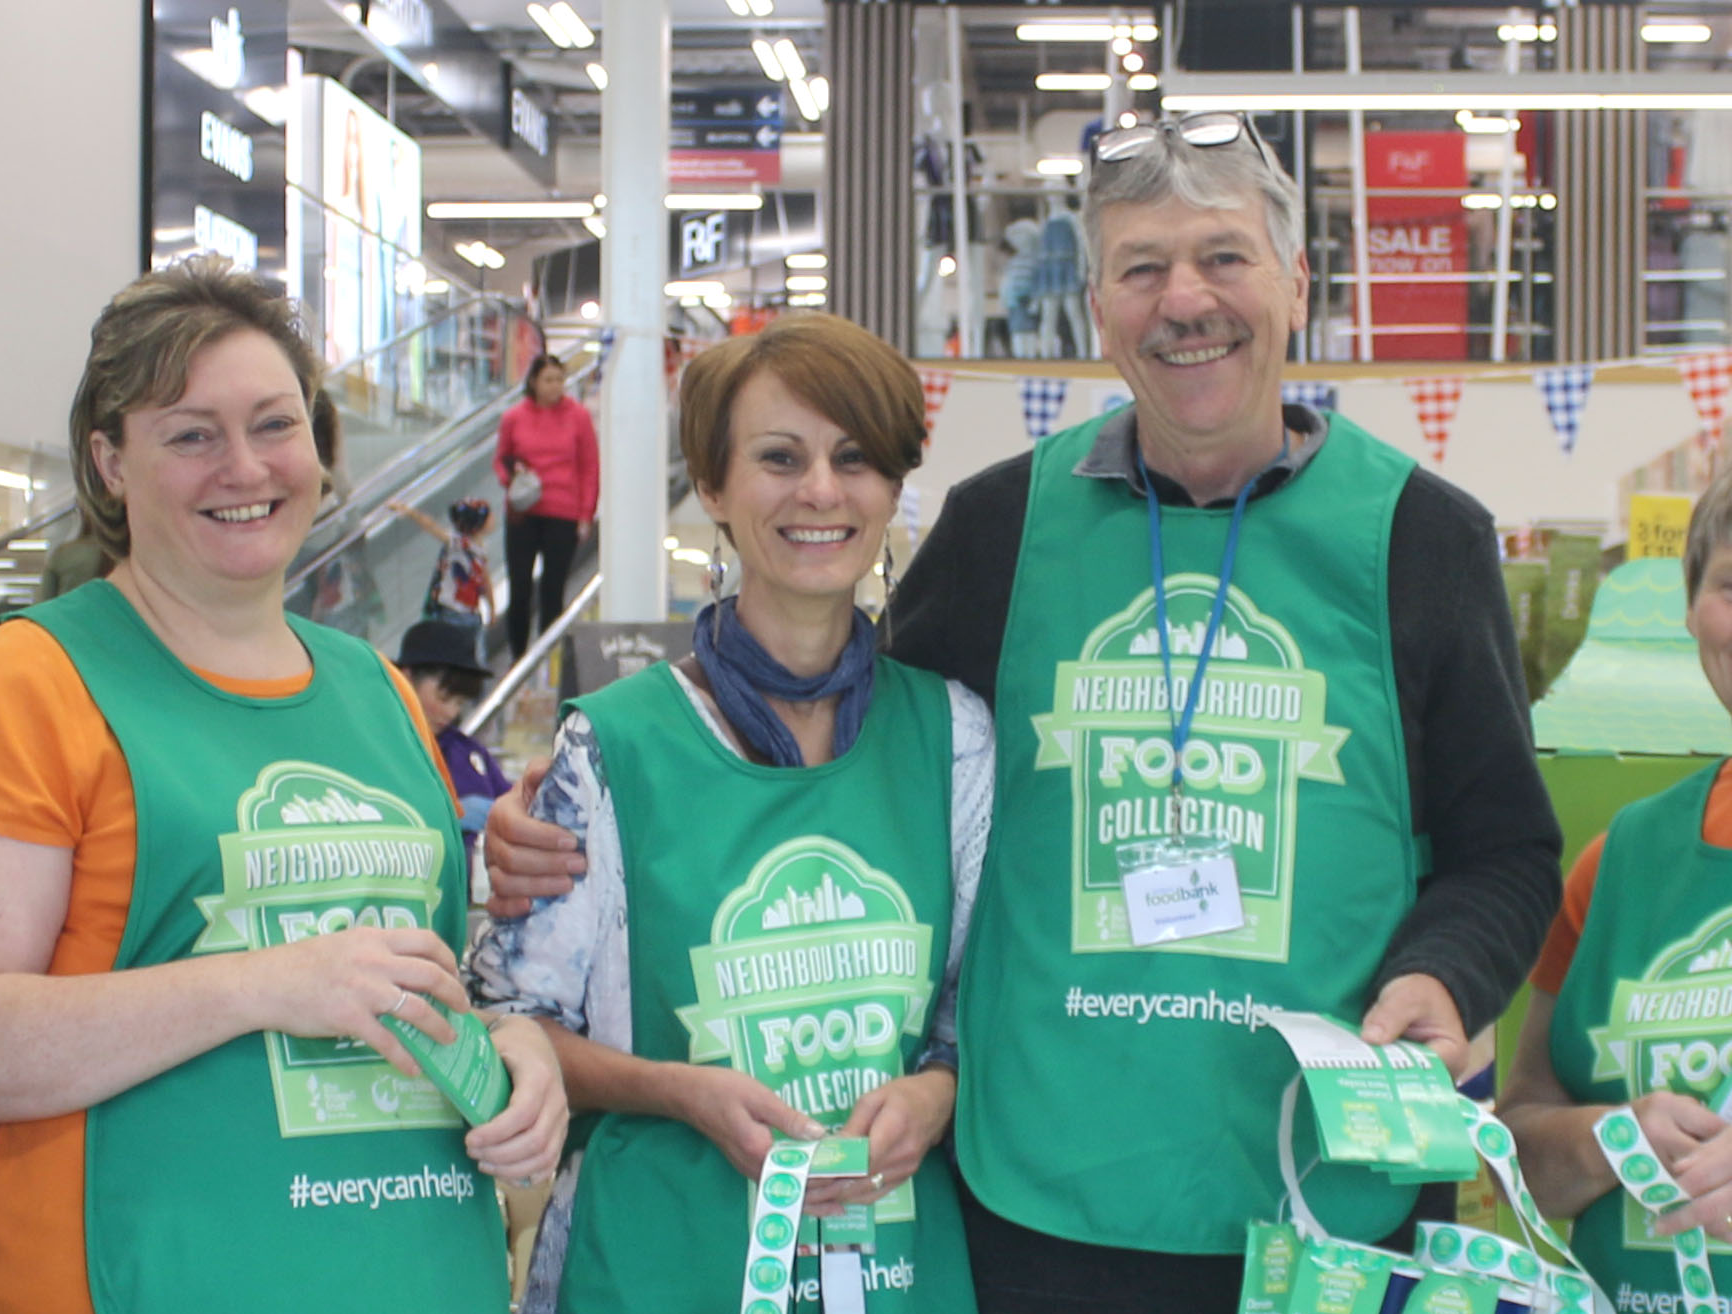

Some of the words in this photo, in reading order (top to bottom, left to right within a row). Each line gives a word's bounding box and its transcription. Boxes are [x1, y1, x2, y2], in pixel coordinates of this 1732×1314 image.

[1369, 226, 1452, 255] SALE
[1098, 737, 1263, 786] FOOD
[244, 839, 435, 891] NEIGHBOURHOOD
[1145, 881, 1220, 907] foodbank
[715, 937, 917, 1000] NEIGHBOURHOOD
[758, 1003, 895, 1064] FOOD
[289, 1164, 475, 1211] #everycanhelps
